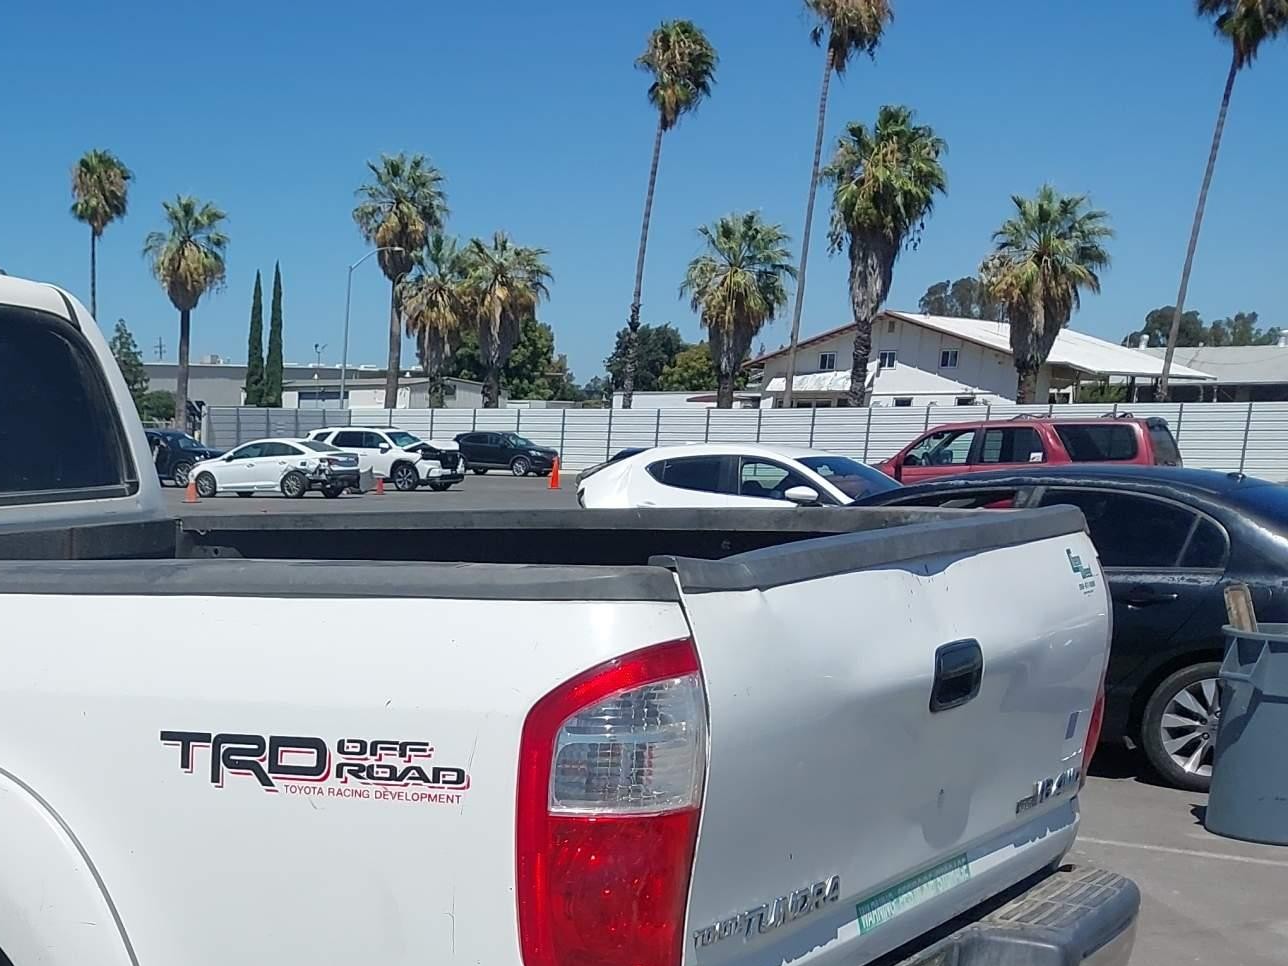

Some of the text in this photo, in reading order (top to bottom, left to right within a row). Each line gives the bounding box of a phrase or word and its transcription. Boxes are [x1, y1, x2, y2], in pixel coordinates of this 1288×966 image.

[160, 730, 330, 792] TRD
[336, 738, 434, 763] OFF
[335, 762, 470, 790] ROAD
[284, 784, 462, 805] TOYOTA RACING DEVELOPMENT
[743, 874, 841, 938] TUNDRA
